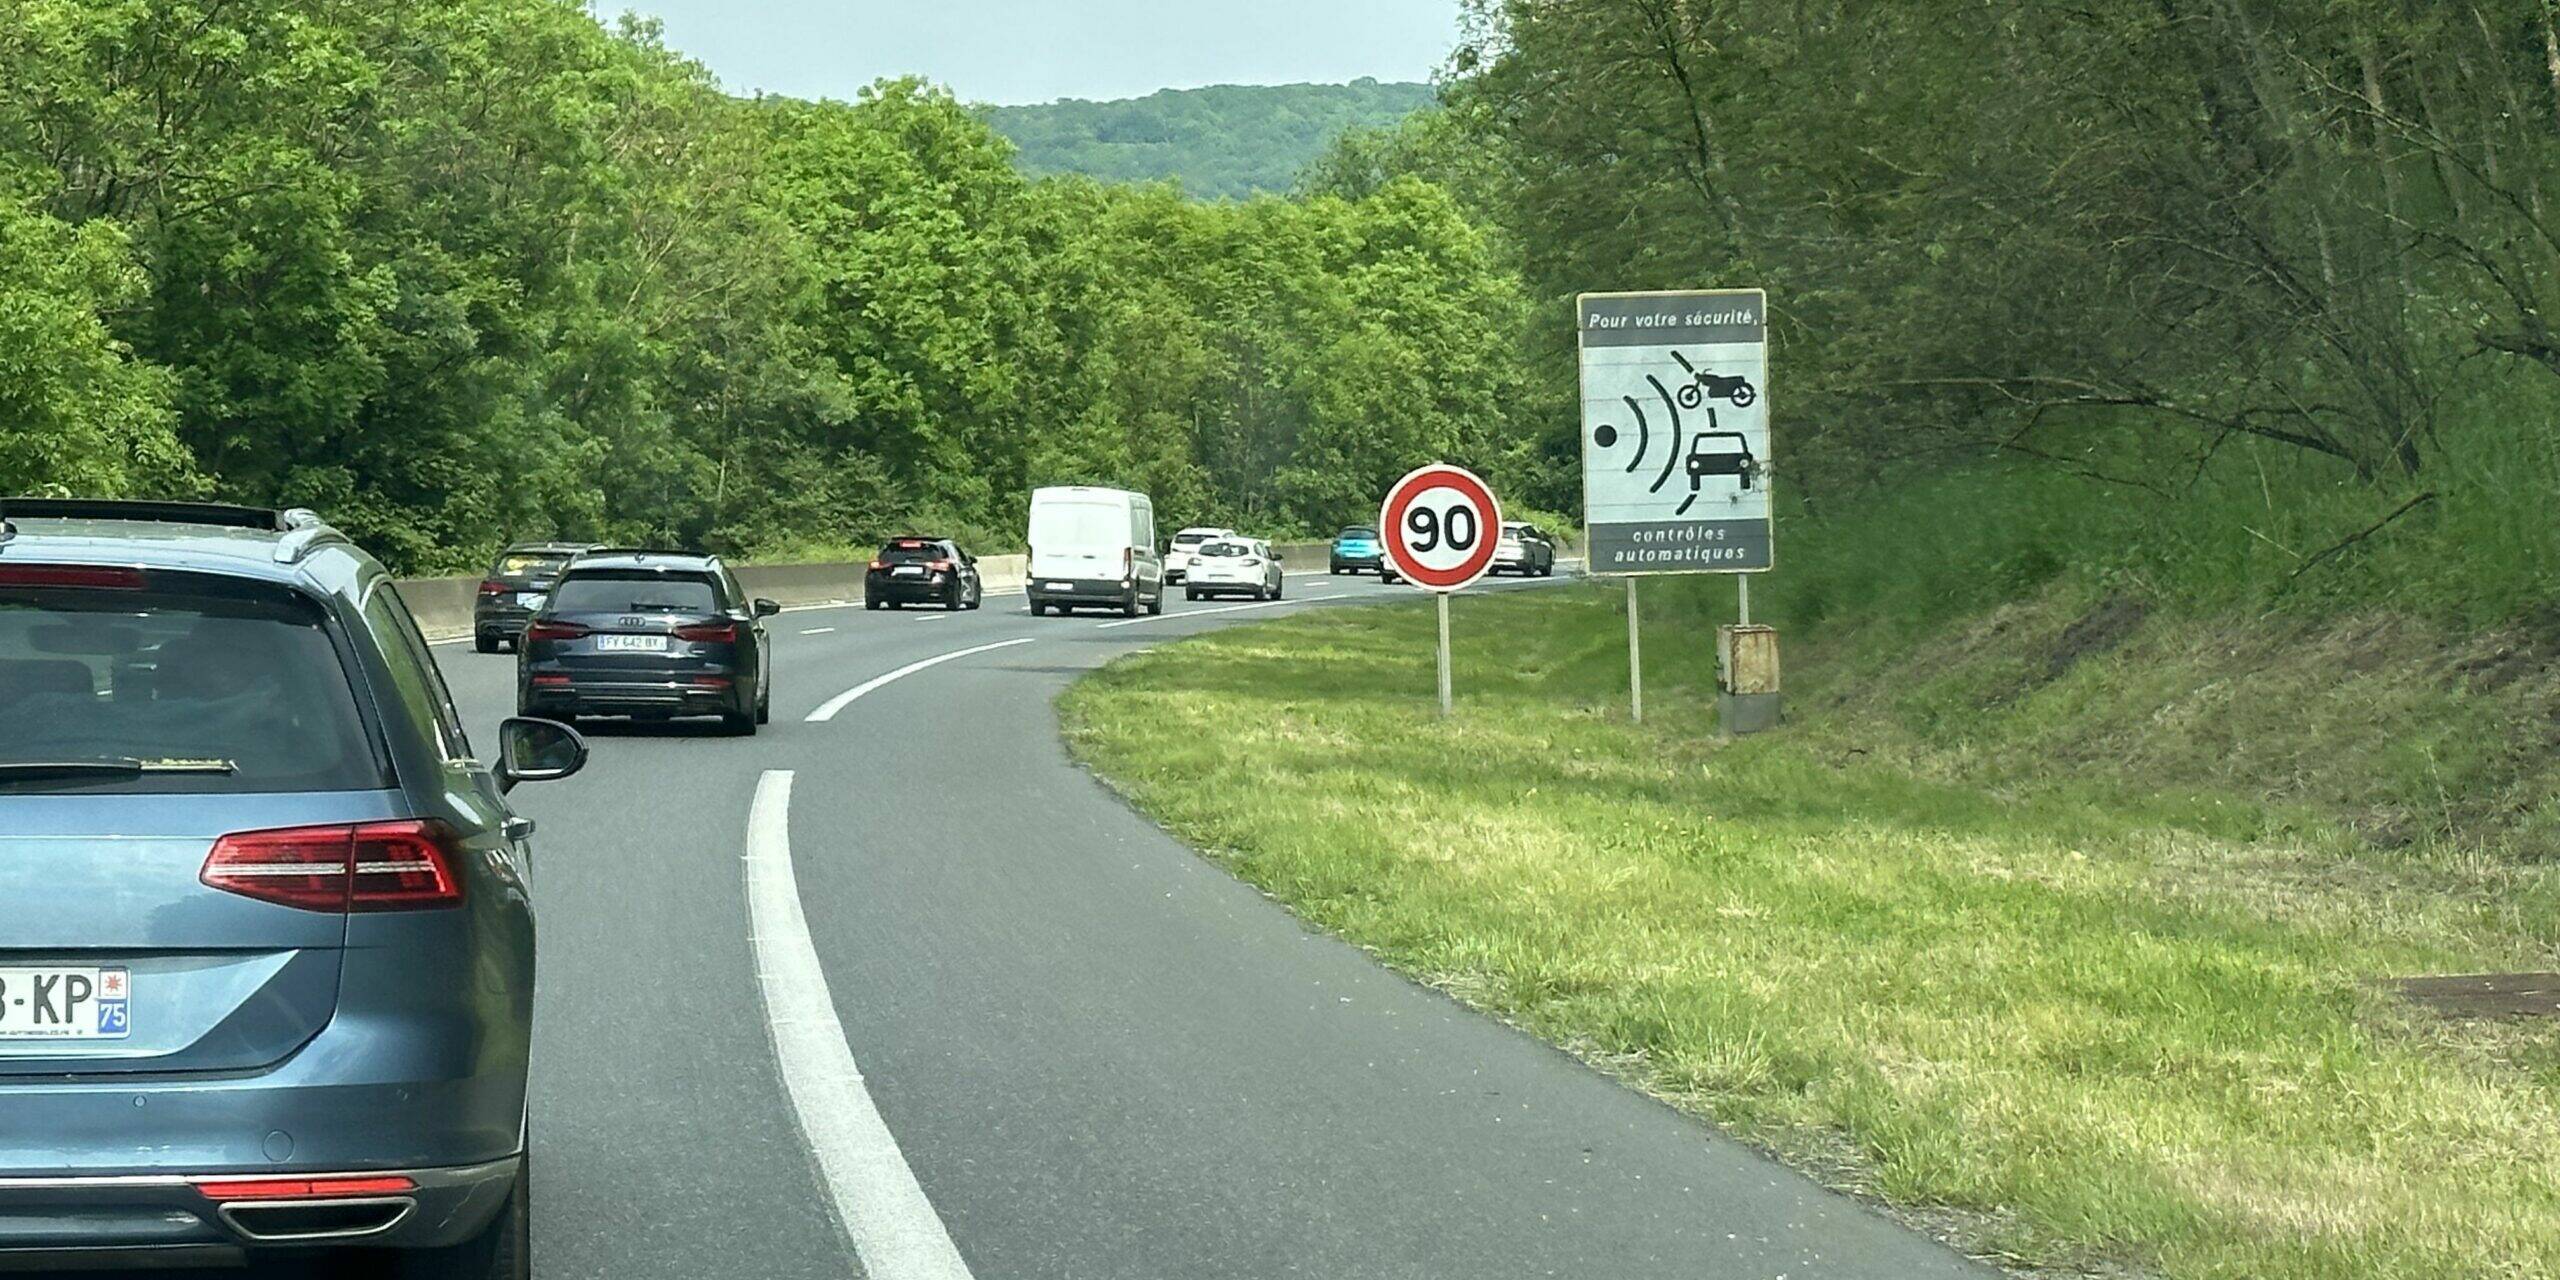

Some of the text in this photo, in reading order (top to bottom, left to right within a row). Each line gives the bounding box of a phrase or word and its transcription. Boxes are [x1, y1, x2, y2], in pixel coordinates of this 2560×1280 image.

[1589, 308, 1758, 329] Pour votre sécurité,
[1407, 505, 1476, 553] 90
[1633, 526, 1727, 543] contrôles
[1614, 545, 1746, 564] automatiques
[0, 974, 92, 1024] -KP
[100, 1003, 126, 1028] 75
